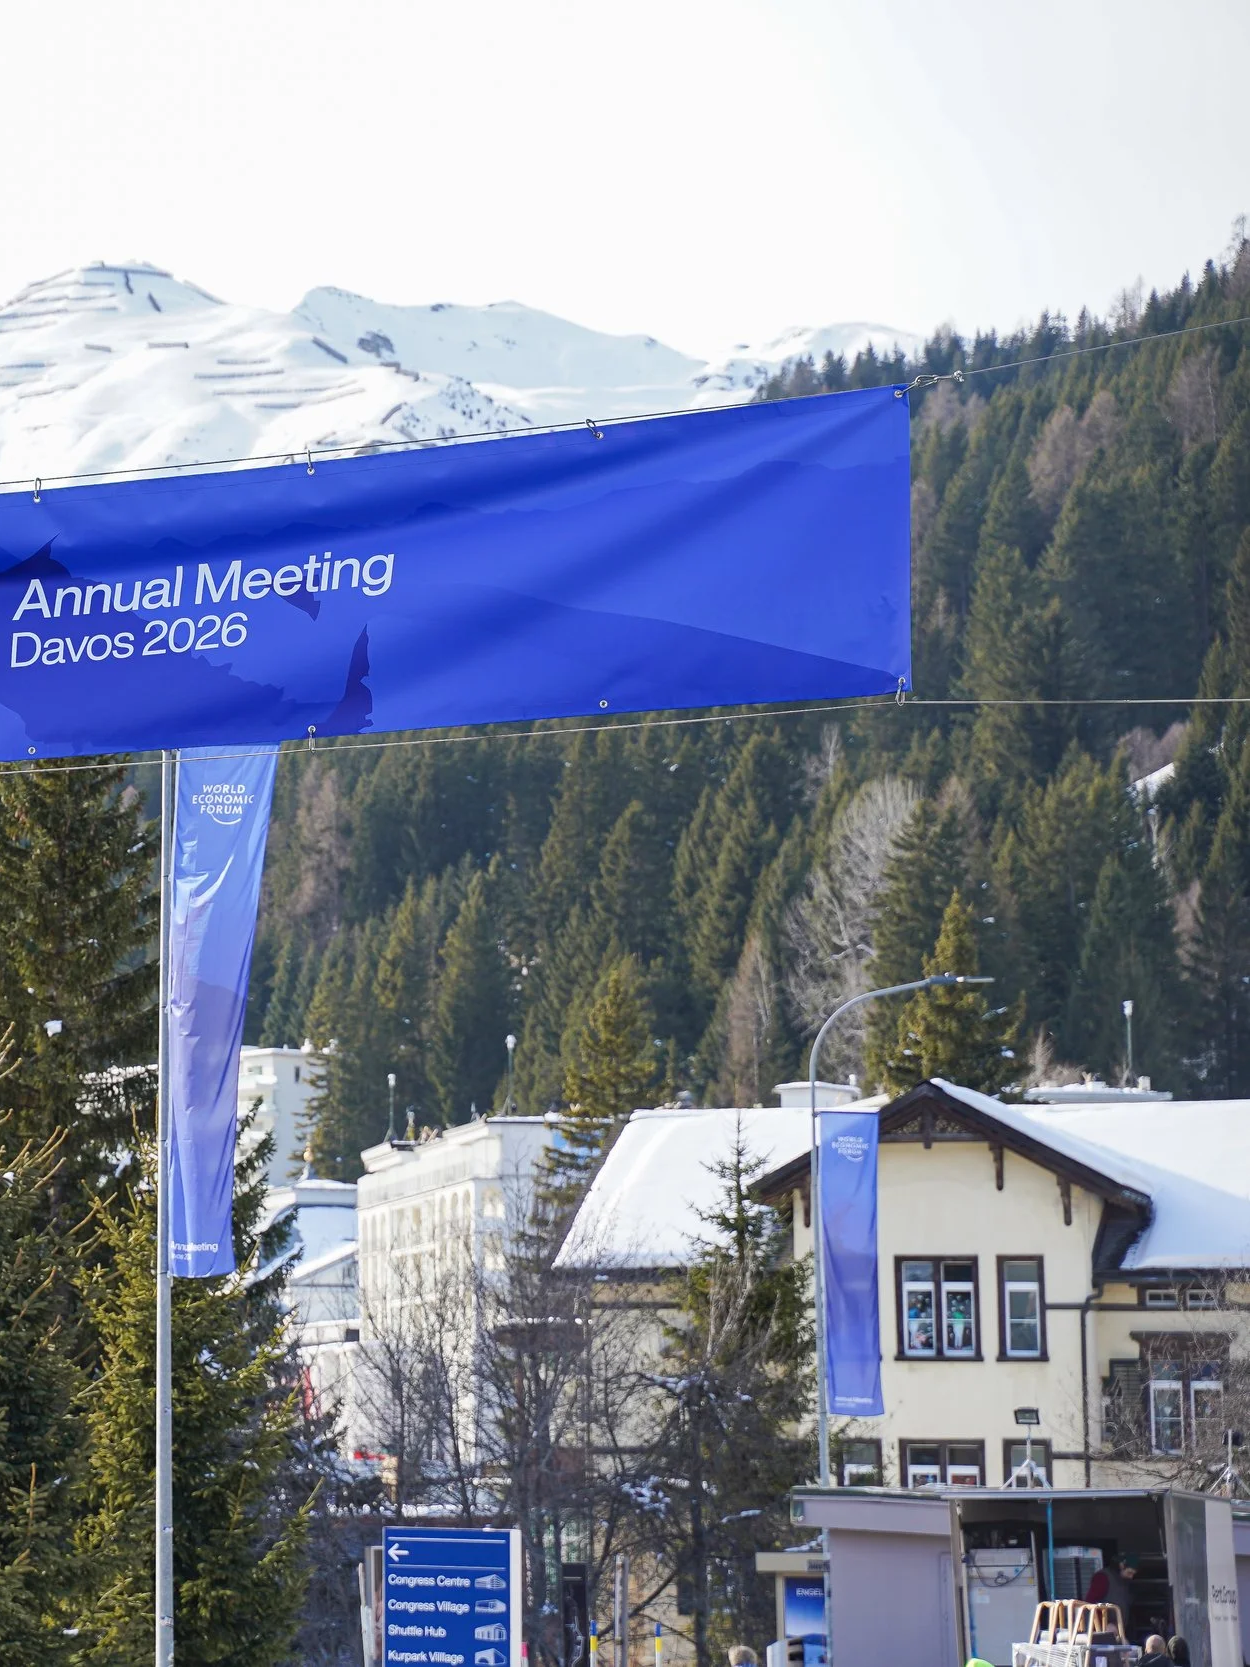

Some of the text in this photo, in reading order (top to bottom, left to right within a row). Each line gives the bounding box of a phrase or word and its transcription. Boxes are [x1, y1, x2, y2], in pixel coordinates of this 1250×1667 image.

[11, 551, 396, 621] Annual Meeting
[10, 612, 249, 668] Davos 2026
[202, 784, 246, 794] WORLD
[192, 794, 255, 804] ECONOMIC
[200, 804, 243, 815] FORUM
[387, 1573, 472, 1588] Congress Centre
[387, 1598, 471, 1616] Congress Village
[387, 1623, 447, 1638] Shuttle Hub
[387, 1649, 429, 1663] Kurpark
